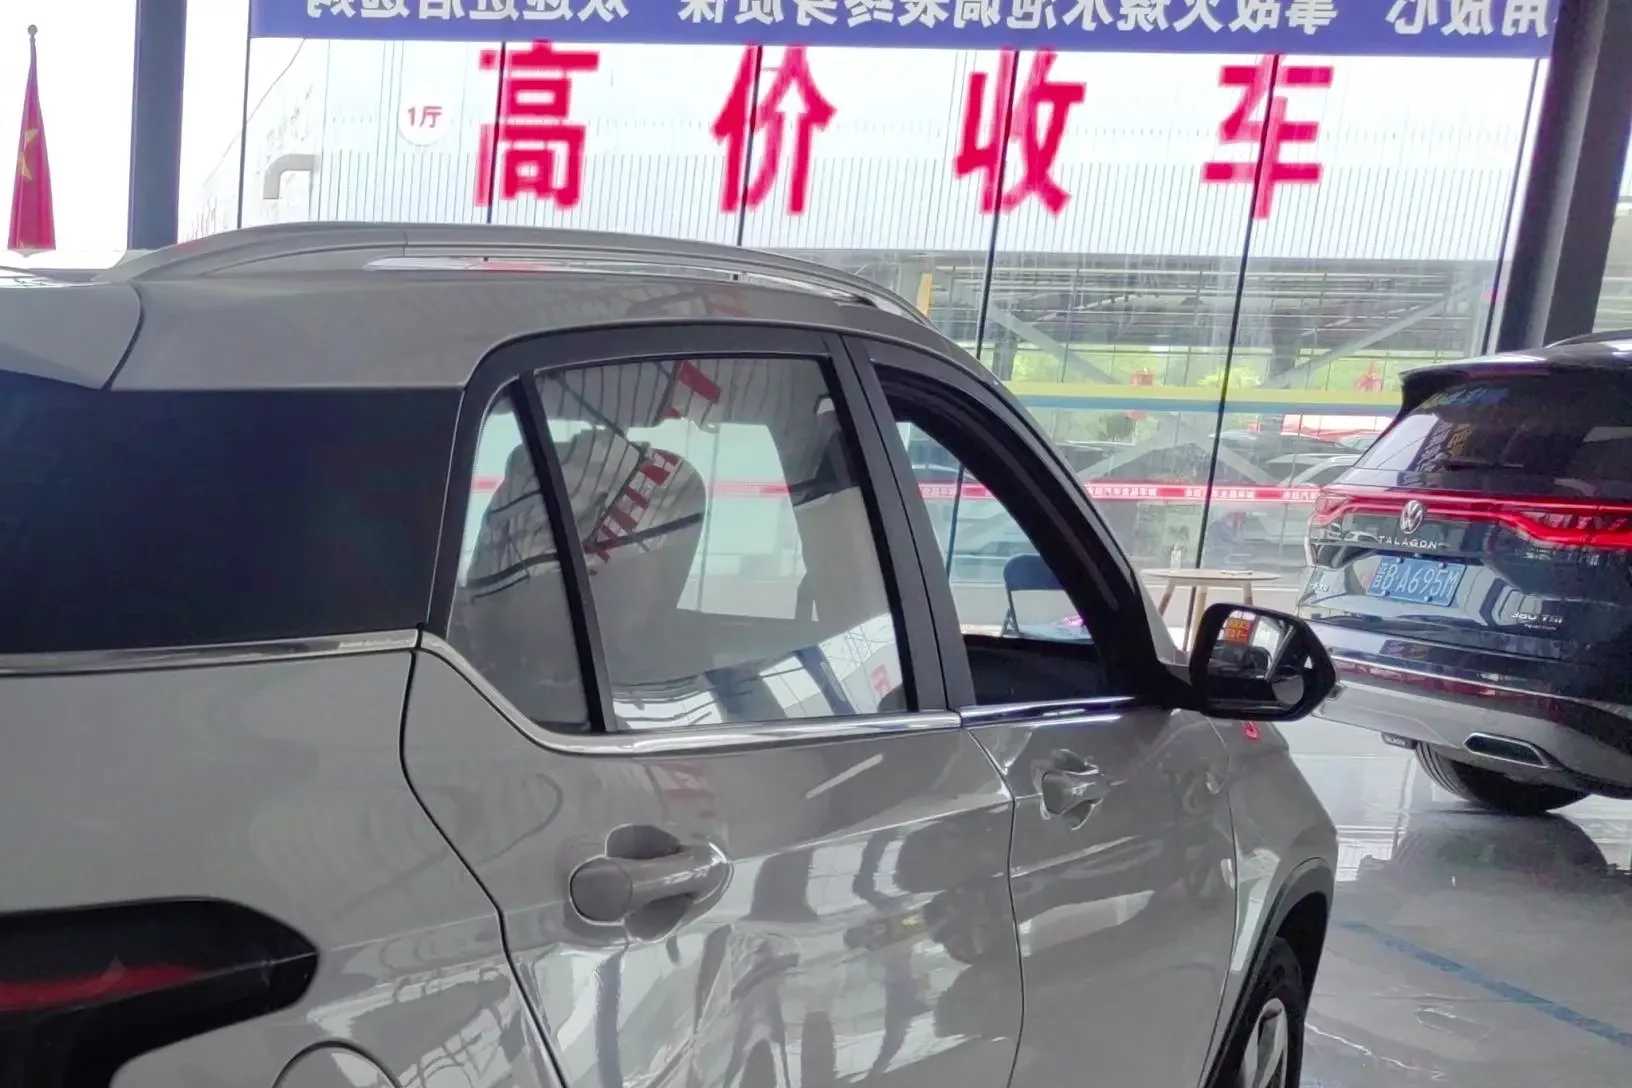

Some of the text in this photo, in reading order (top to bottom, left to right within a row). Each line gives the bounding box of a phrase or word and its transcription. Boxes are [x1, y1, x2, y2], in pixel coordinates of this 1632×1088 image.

[407, 105, 442, 128] 1厅
[474, 39, 1334, 220] 高价收车
[1378, 535, 1438, 549] TALAGON
